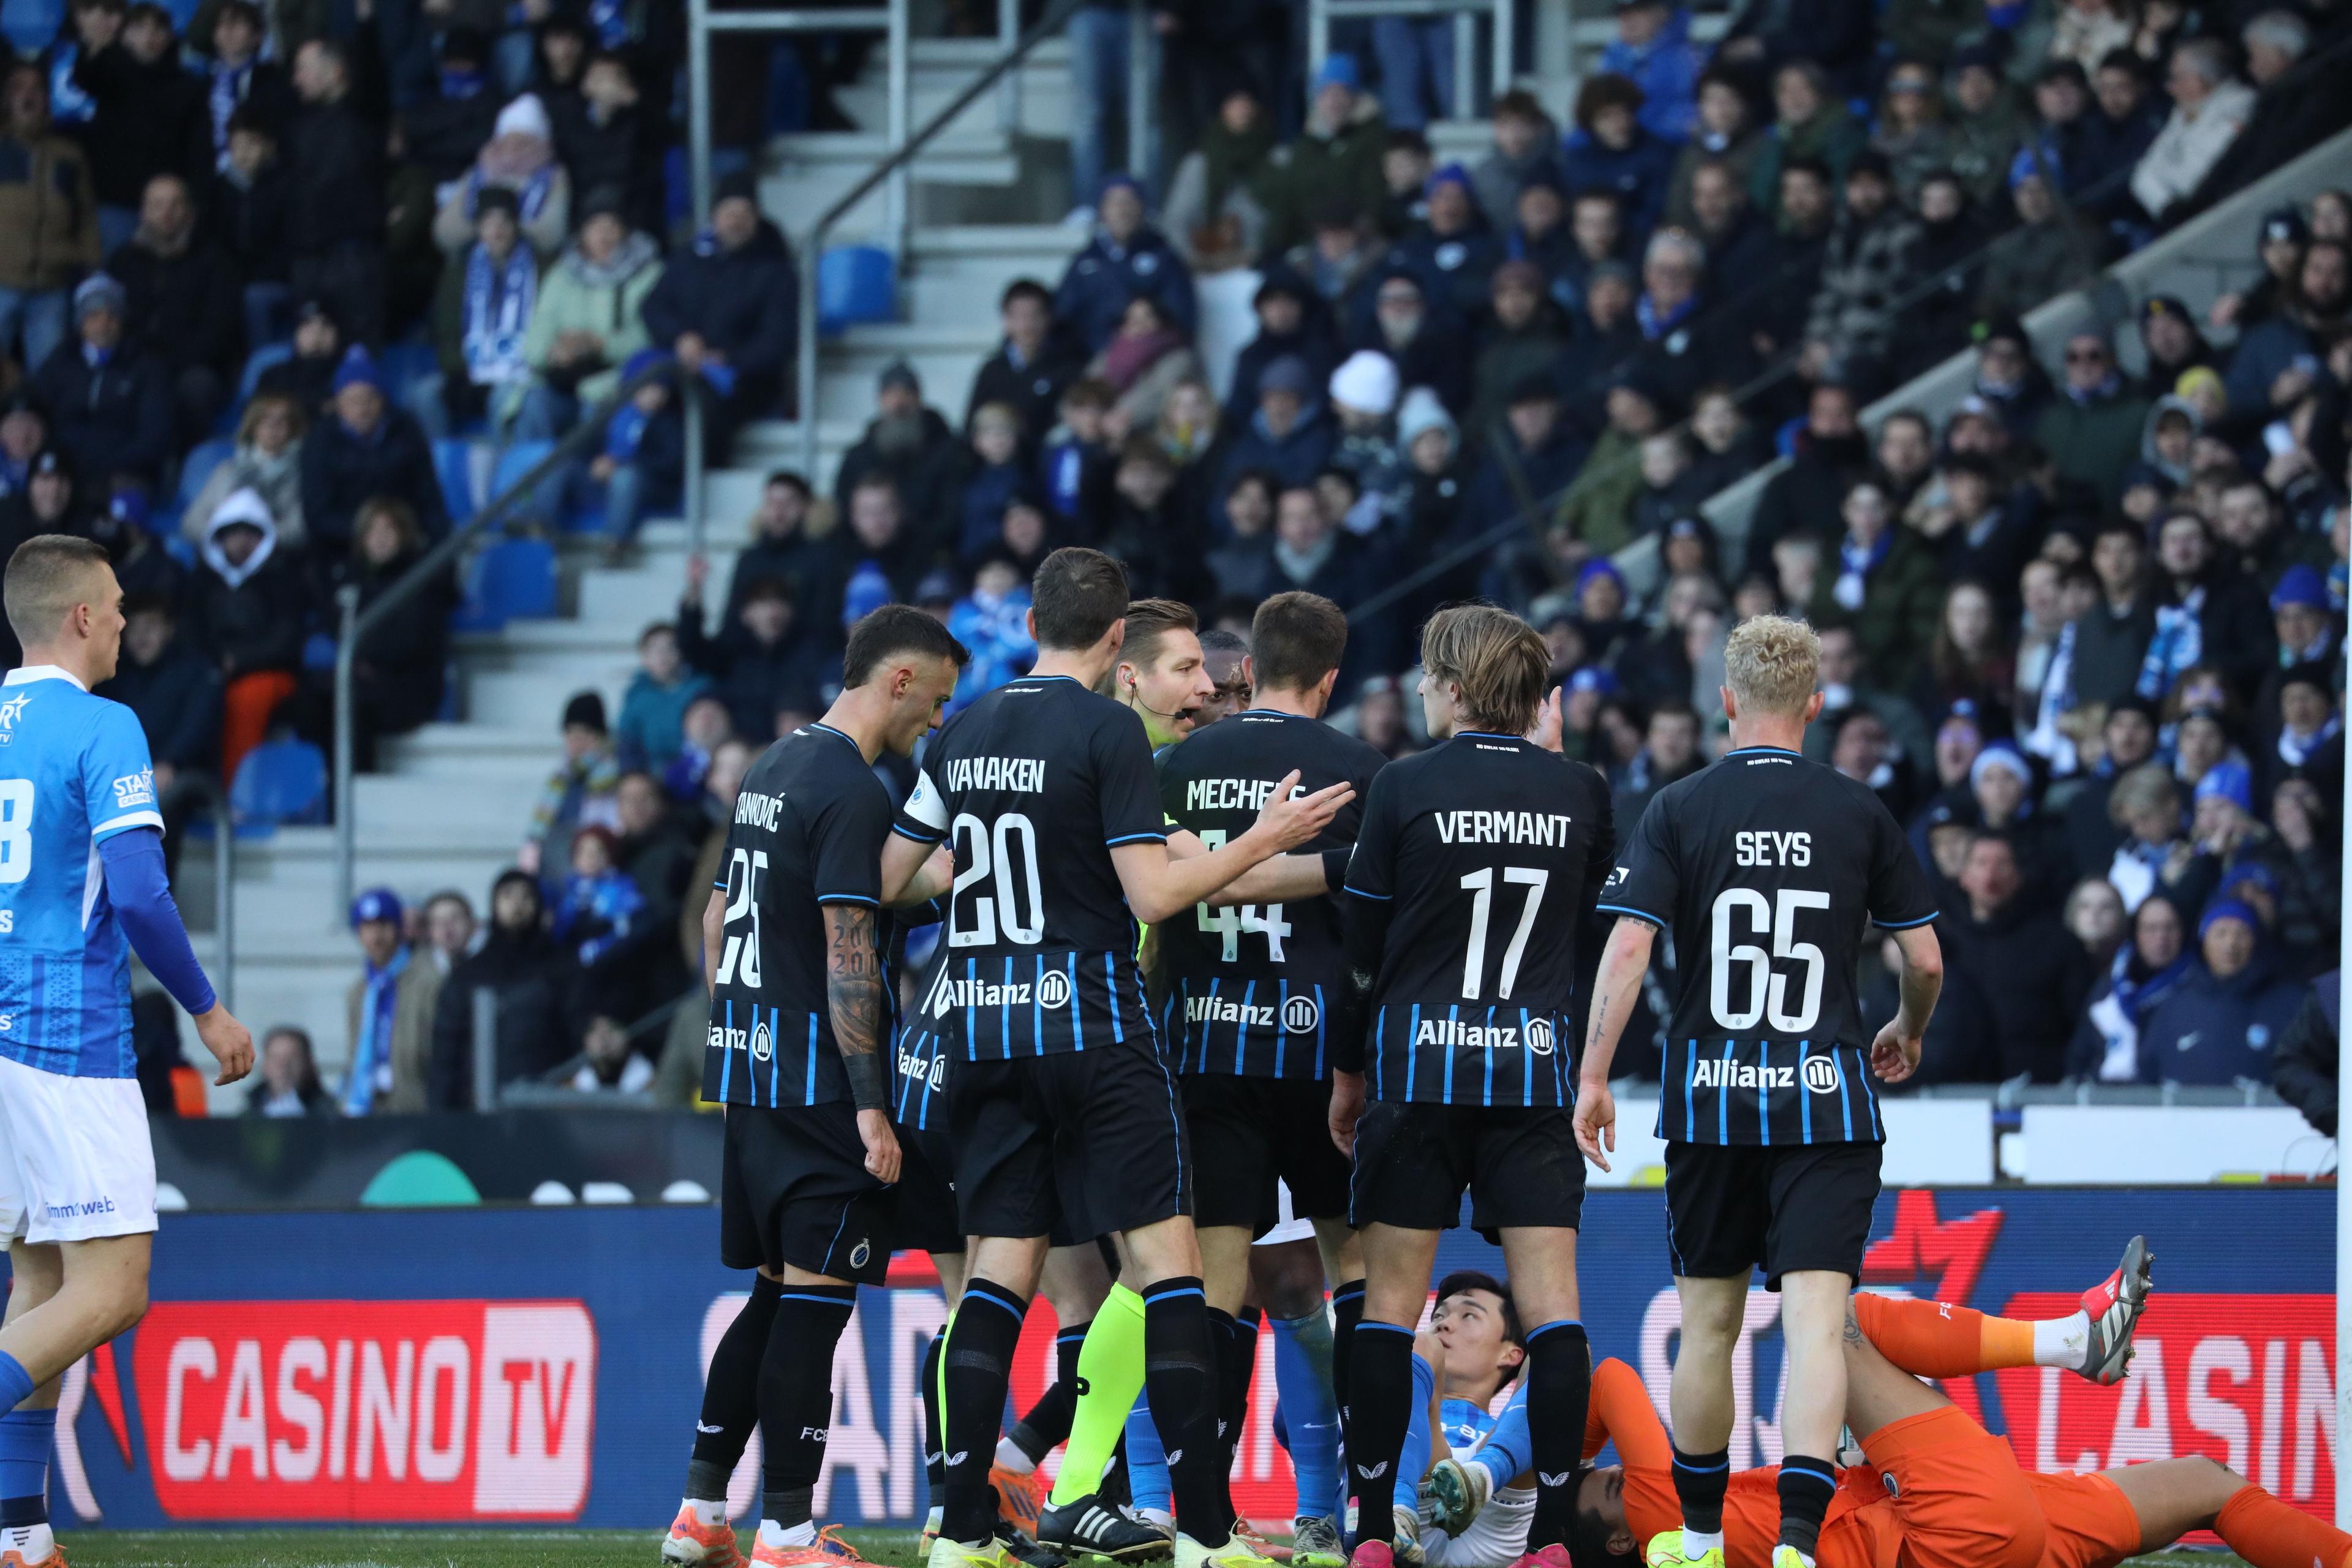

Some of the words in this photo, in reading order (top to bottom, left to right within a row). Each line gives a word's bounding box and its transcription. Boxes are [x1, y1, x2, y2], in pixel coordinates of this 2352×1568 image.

[1435, 811, 1571, 848] VERMANT
[1736, 831, 1811, 867] SEYS
[948, 812, 1045, 948] 20
[715, 848, 768, 988] 25
[1460, 867, 1549, 1000] 17
[1710, 888, 1830, 1033] 65
[948, 979, 1030, 1007] Allianz
[1185, 997, 1274, 1026] Allianz
[706, 1019, 747, 1050] ianz
[1415, 1020, 1518, 1048] Allianz
[1692, 1060, 1794, 1088] Allianz
[163, 1335, 470, 1482] CASINO
[501, 1360, 575, 1457] TV
